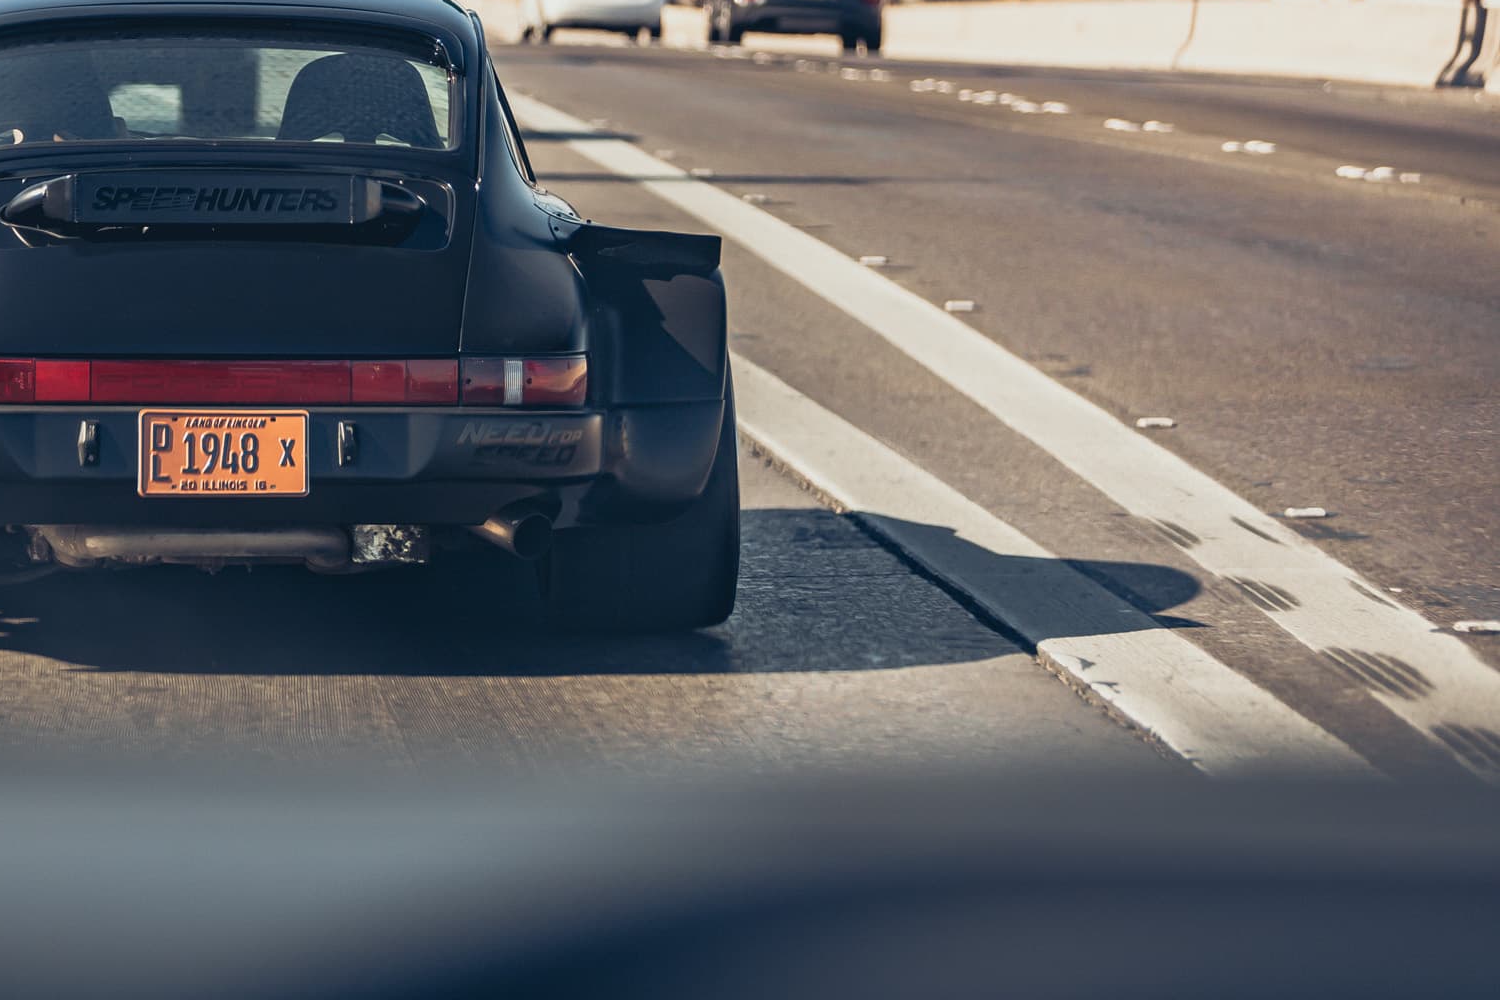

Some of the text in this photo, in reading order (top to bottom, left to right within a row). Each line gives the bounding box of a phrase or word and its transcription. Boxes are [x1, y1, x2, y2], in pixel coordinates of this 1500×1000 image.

[92, 186, 340, 215] SPEEDHUNTERS
[184, 416, 211, 429] LAND
[180, 431, 260, 475] 1948
[278, 436, 296, 468] X
[201, 480, 248, 492] ILLINOIS
